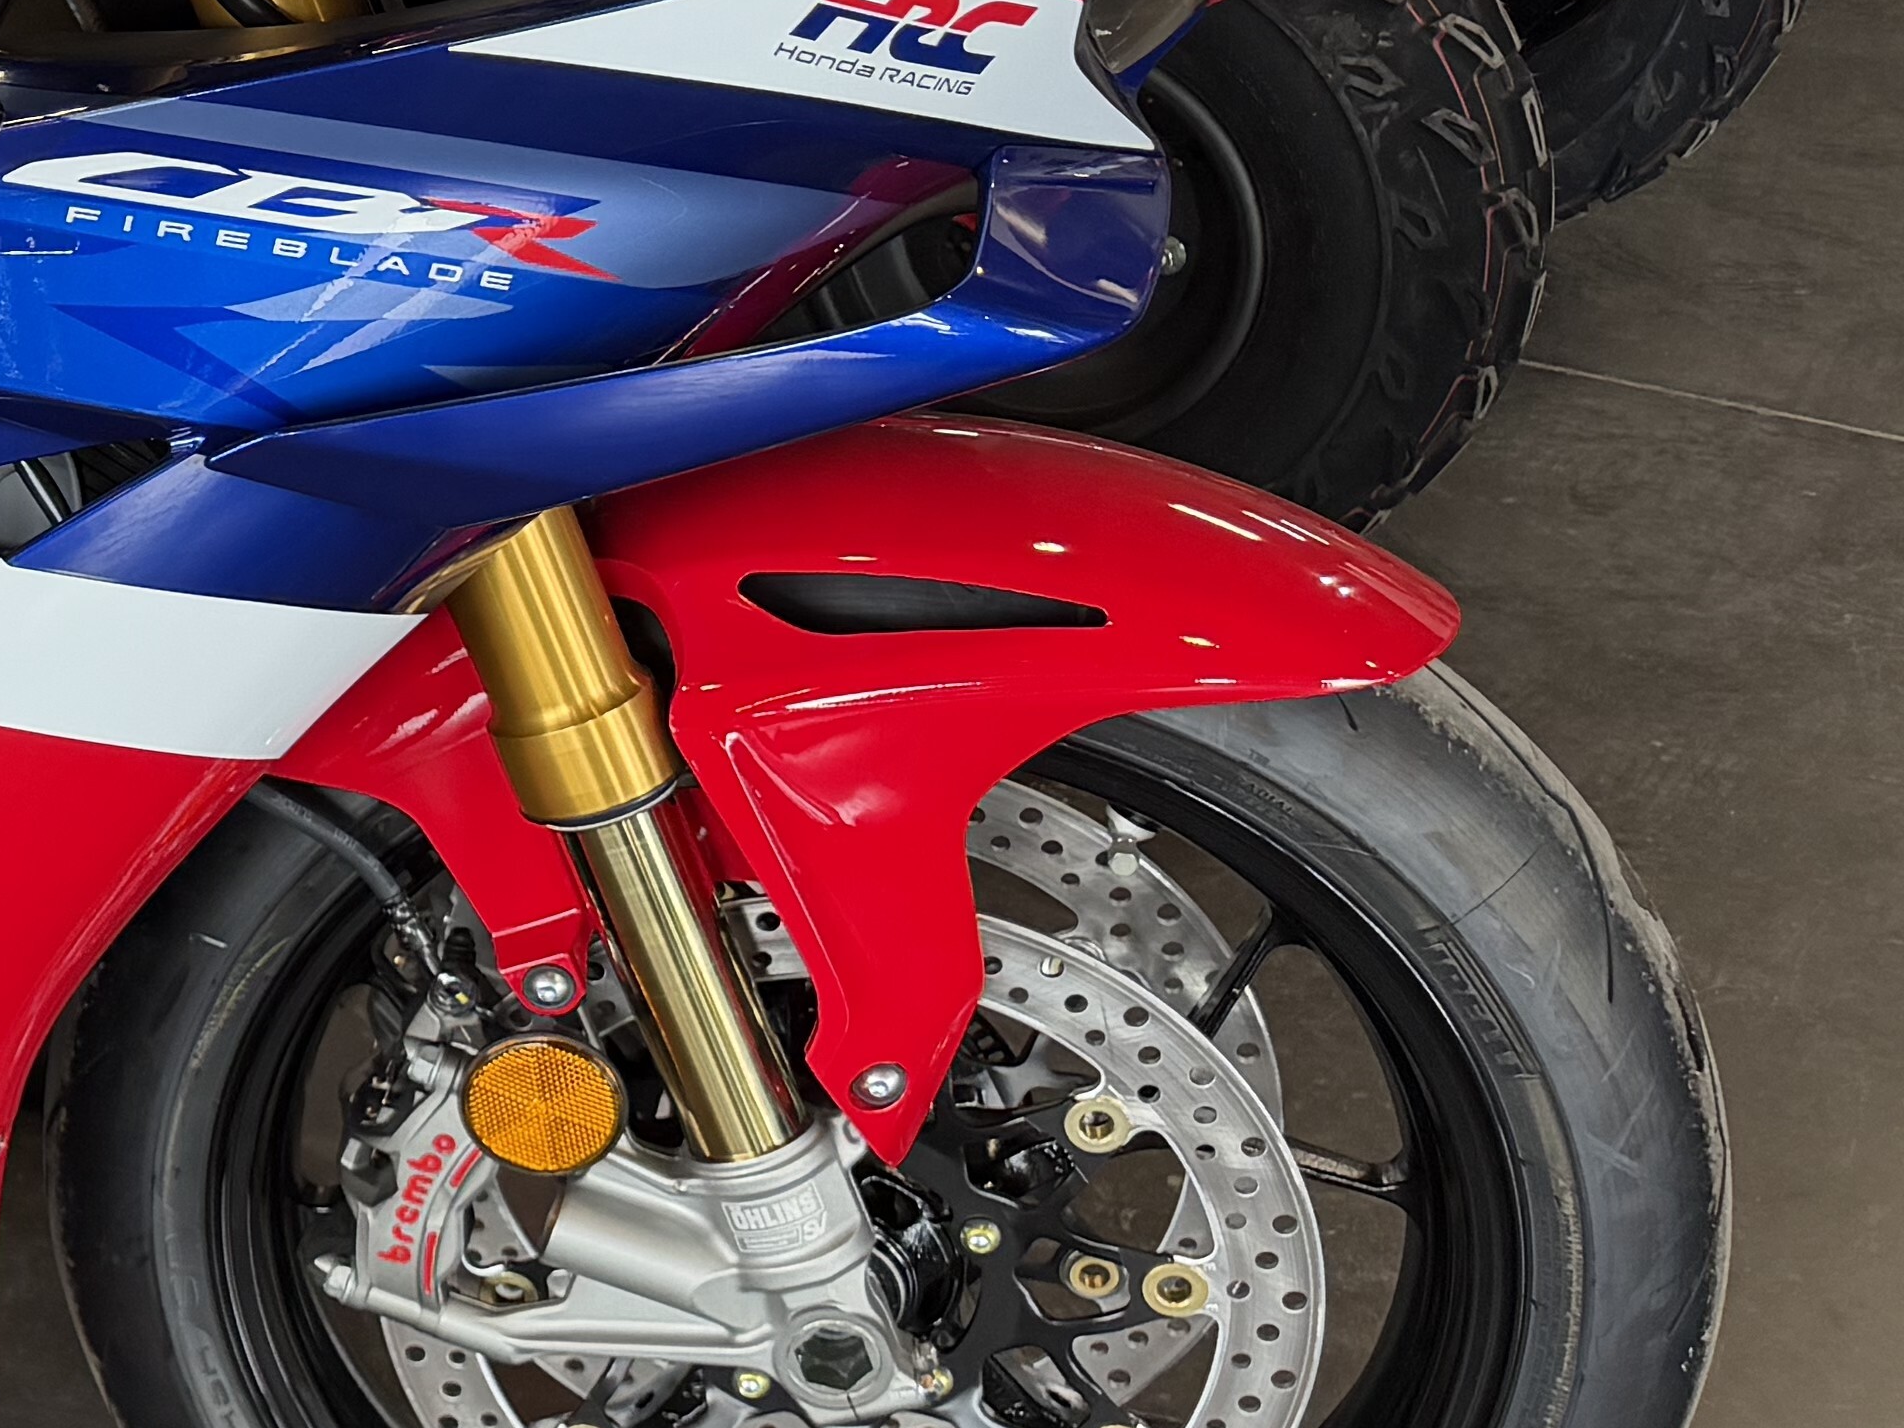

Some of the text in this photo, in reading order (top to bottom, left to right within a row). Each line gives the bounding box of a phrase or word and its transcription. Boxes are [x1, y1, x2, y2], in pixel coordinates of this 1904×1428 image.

[774, 42, 976, 96] Honda RACING
[1, 151, 622, 282] CBR
[64, 206, 515, 293] FIREBLADE
[377, 1132, 458, 1265] brembo
[731, 1187, 827, 1233] ÖHLINS
